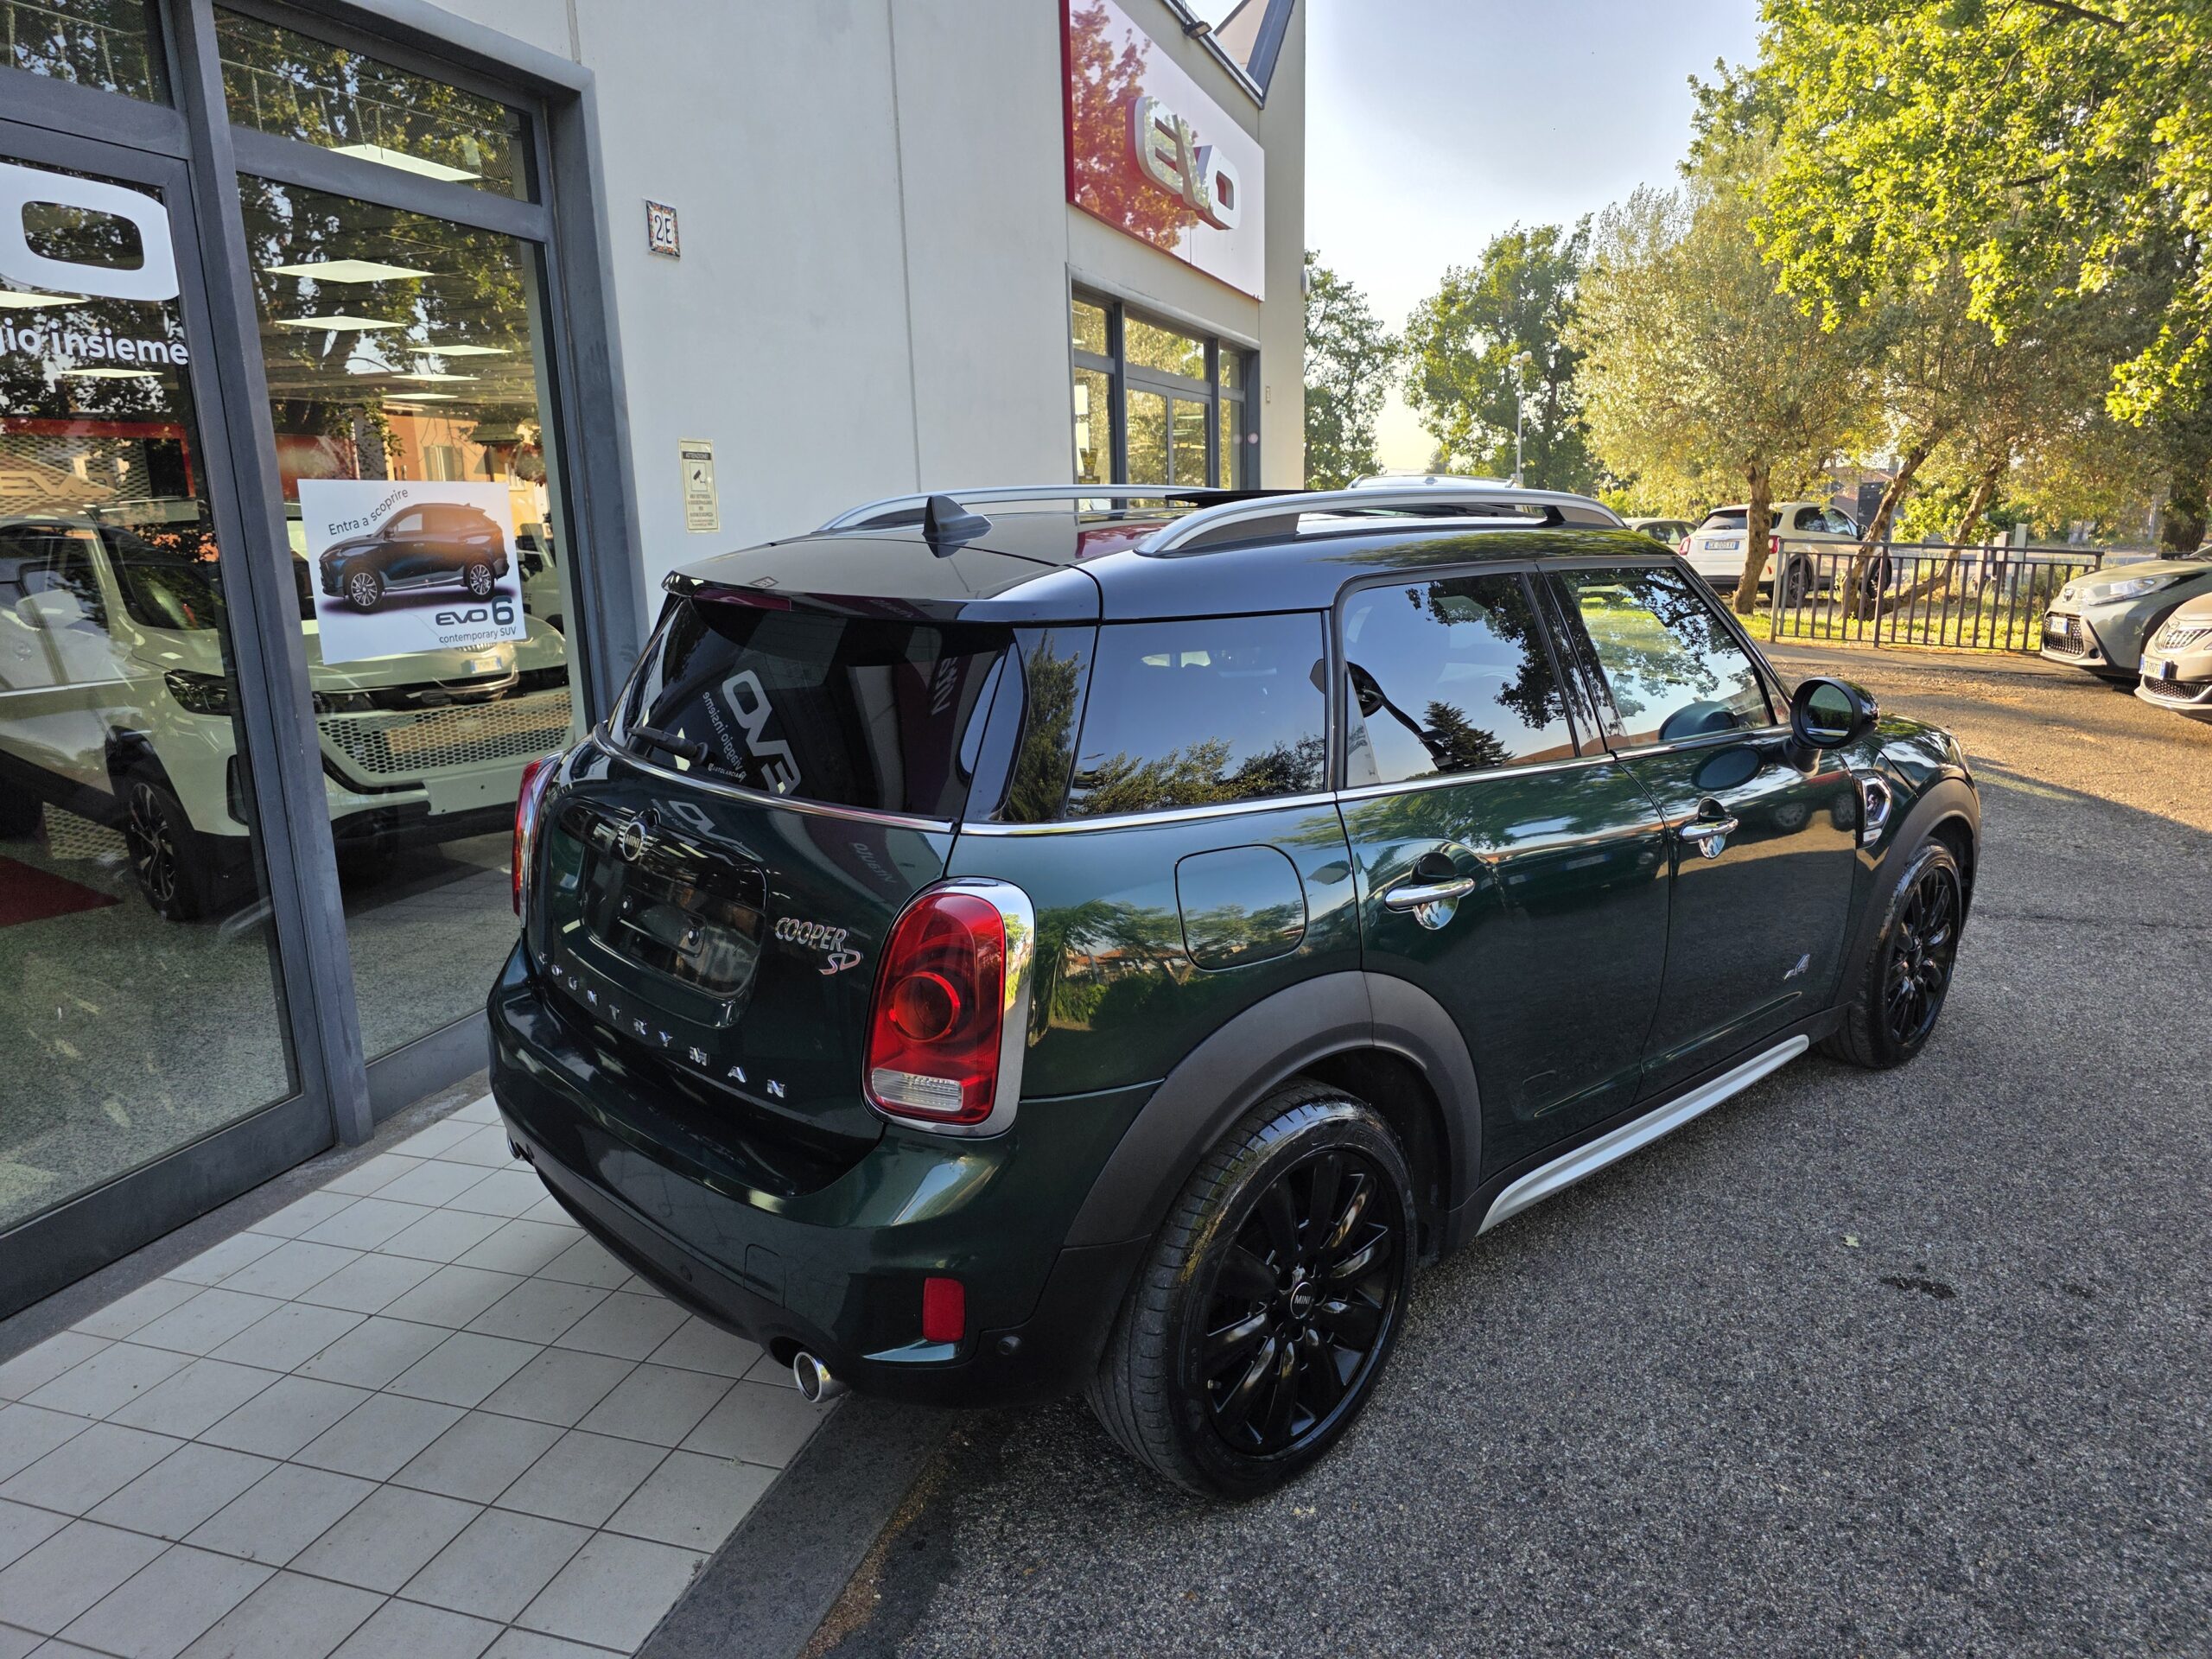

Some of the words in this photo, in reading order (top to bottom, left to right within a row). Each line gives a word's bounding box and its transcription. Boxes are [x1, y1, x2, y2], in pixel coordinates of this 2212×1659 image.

[1133, 95, 1241, 230] EVO
[654, 214, 672, 244] 2E
[50, 321, 188, 365] insieme
[328, 519, 359, 536] Entra
[362, 518, 369, 526] a
[370, 489, 409, 521] scoprire
[435, 608, 488, 626] EVO
[491, 594, 514, 626] 6
[439, 631, 499, 644] contemporary
[499, 626, 517, 637] SUV
[624, 834, 641, 849] MINI
[775, 917, 847, 952] COOPER
[818, 948, 861, 976] SD
[537, 951, 788, 1099] COUNTRYMAN
[1294, 1294, 1312, 1305] MINI
